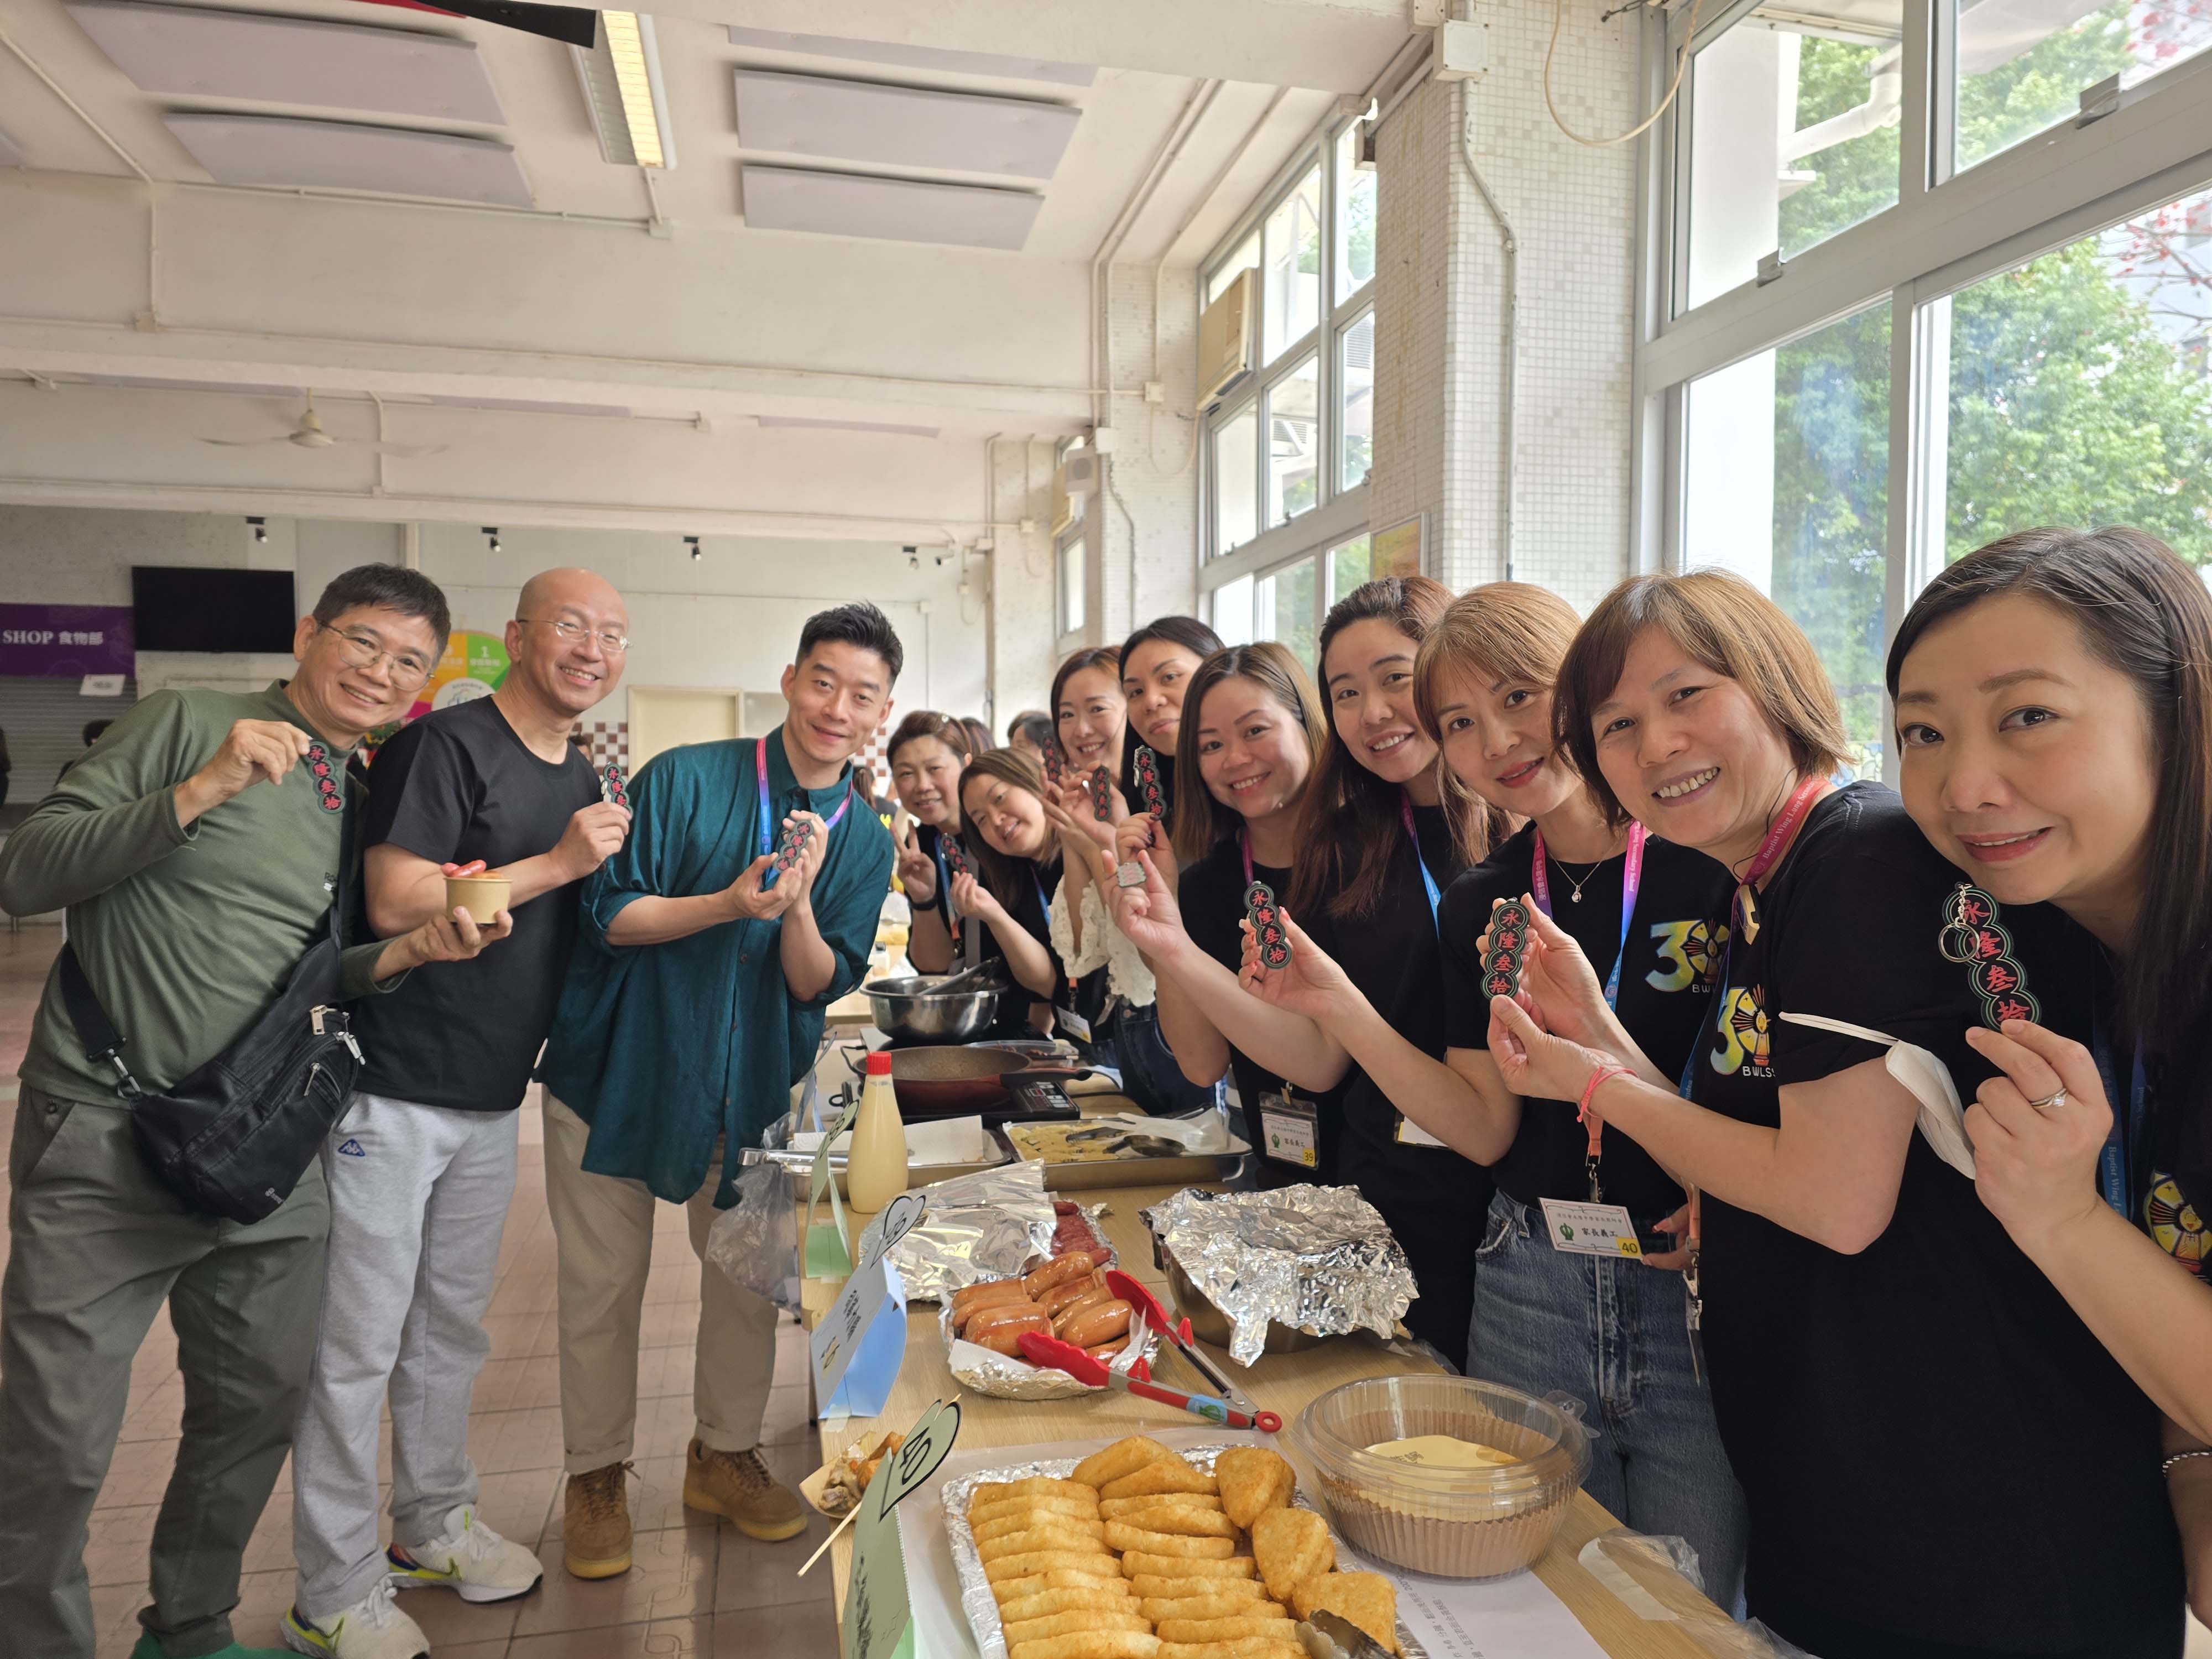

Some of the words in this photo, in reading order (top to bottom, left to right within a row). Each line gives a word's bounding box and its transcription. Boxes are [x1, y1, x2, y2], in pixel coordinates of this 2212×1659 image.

[2, 629, 54, 645] SHOP
[59, 630, 104, 646] 食物部
[480, 646, 489, 658] 1
[1762, 835, 1779, 859] Baptist
[1775, 814, 1792, 836] Wing
[1787, 797, 1803, 817] Lung
[1252, 890, 1286, 963] 永隆叁拾
[1489, 909, 1521, 994] 永隆叁拾
[1961, 899, 2030, 1022] 永隆叁拾
[1305, 1151, 1314, 1162] 39
[1582, 1227, 1618, 1239] 家長義工
[1622, 1243, 1638, 1253] 40
[899, 1426, 932, 1485] 40
